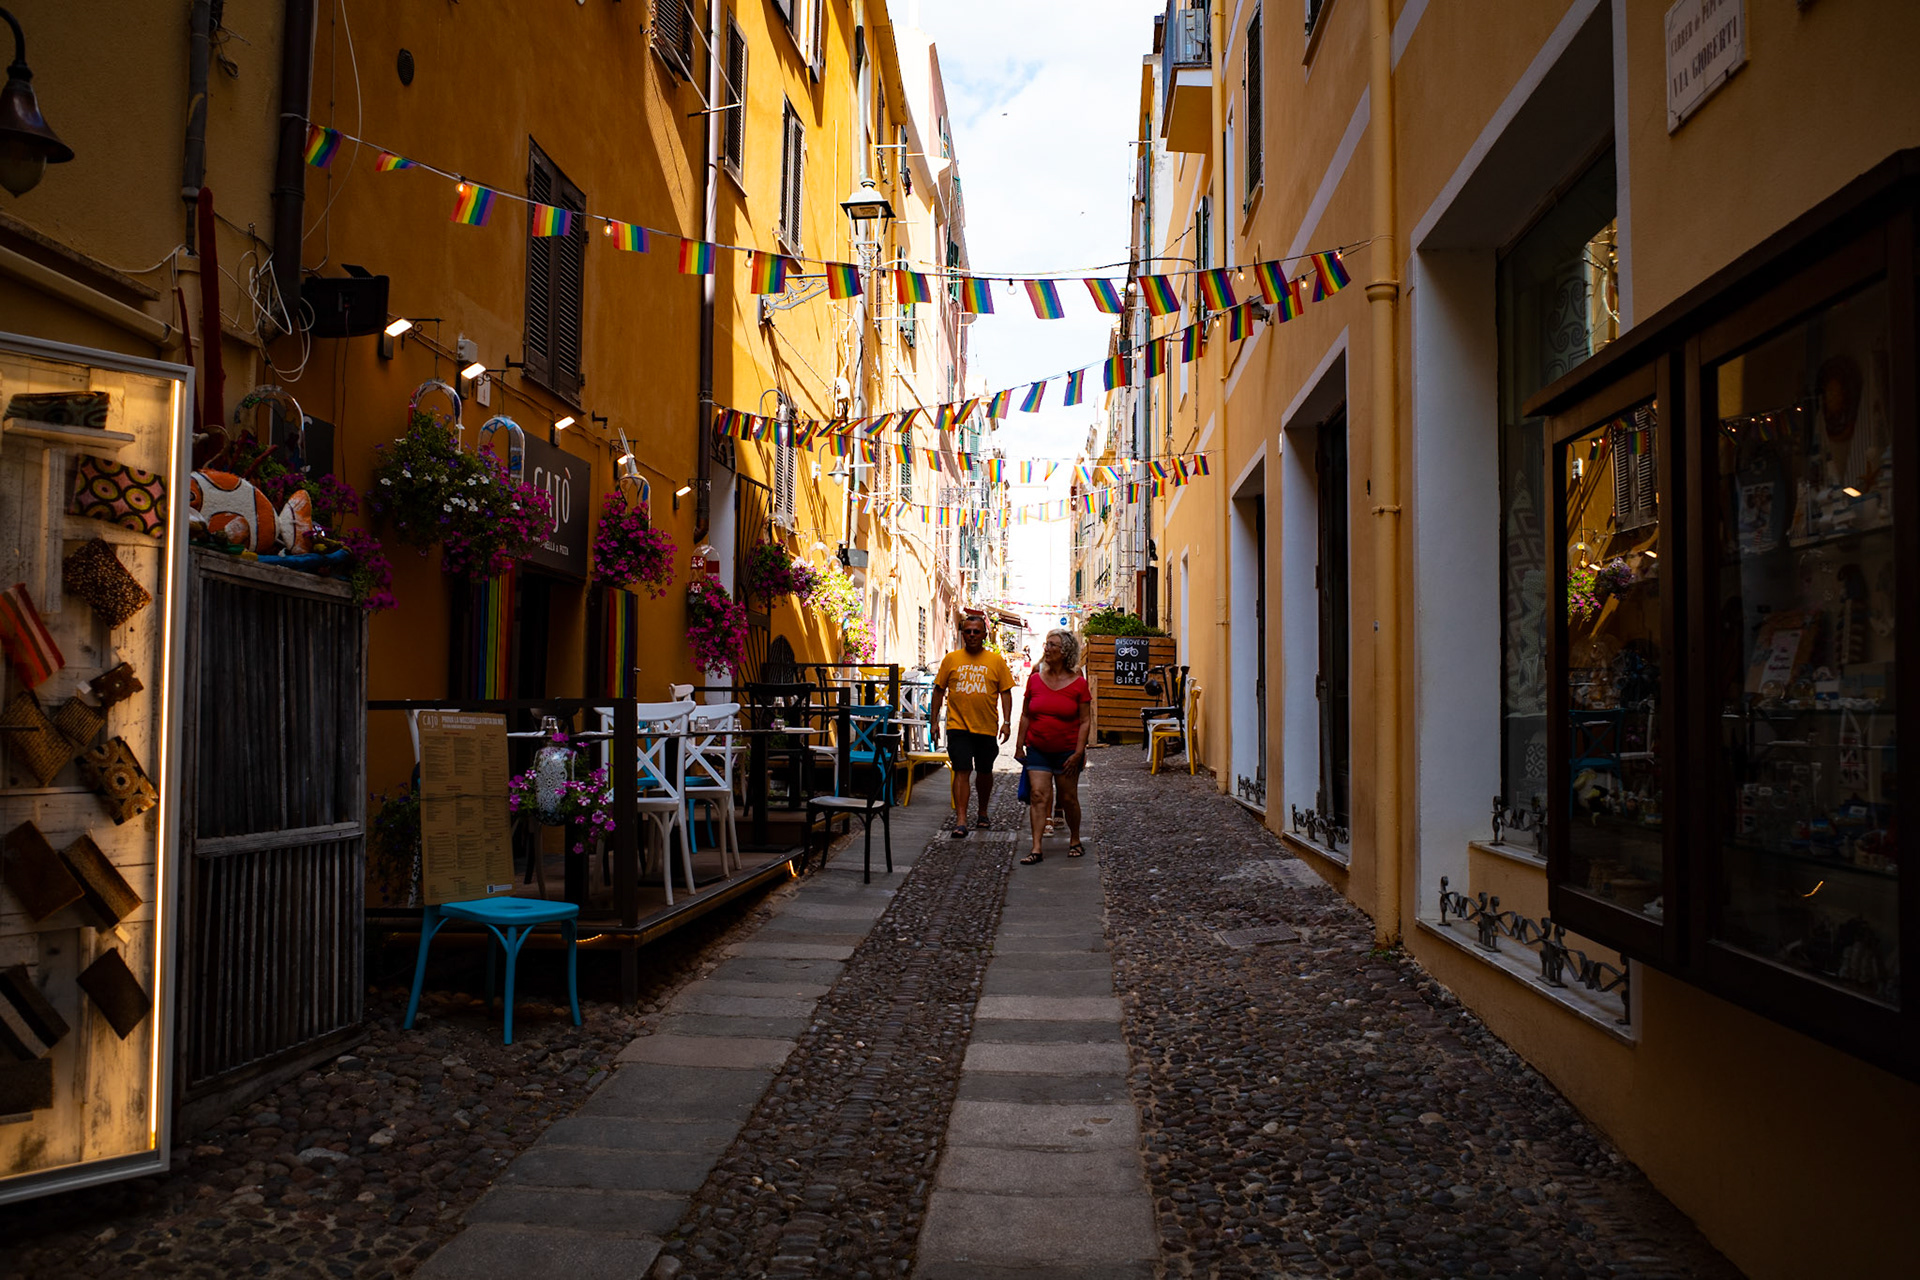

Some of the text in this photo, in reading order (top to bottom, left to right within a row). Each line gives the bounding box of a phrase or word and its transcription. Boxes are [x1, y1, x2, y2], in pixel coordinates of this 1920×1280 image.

[1674, 15, 1737, 97] VIA GIOBERTI
[1116, 660, 1147, 671] RENT
[959, 671, 986, 683] DI VITA
[1115, 676, 1141, 685] BIKE
[956, 681, 987, 695] BUONA
